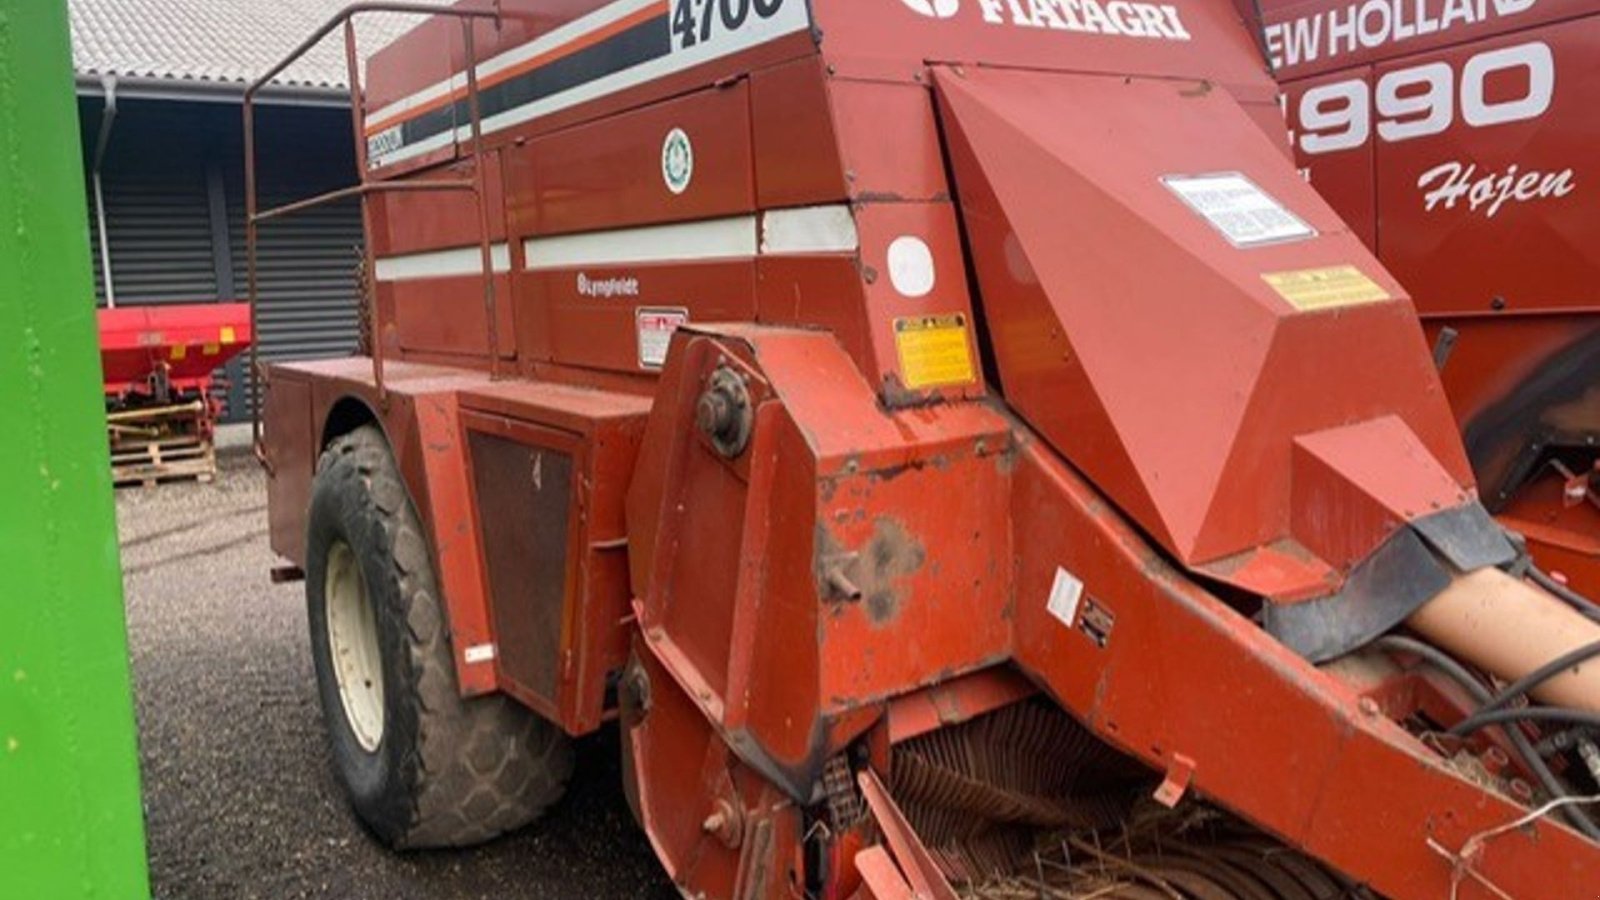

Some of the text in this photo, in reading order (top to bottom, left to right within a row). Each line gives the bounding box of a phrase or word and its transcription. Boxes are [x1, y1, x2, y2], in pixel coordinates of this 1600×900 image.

[979, 0, 1191, 40] FIATAGRI
[1264, 14, 1322, 69] EW
[1279, 41, 1554, 155] 990
[1417, 161, 1576, 217] Højen
